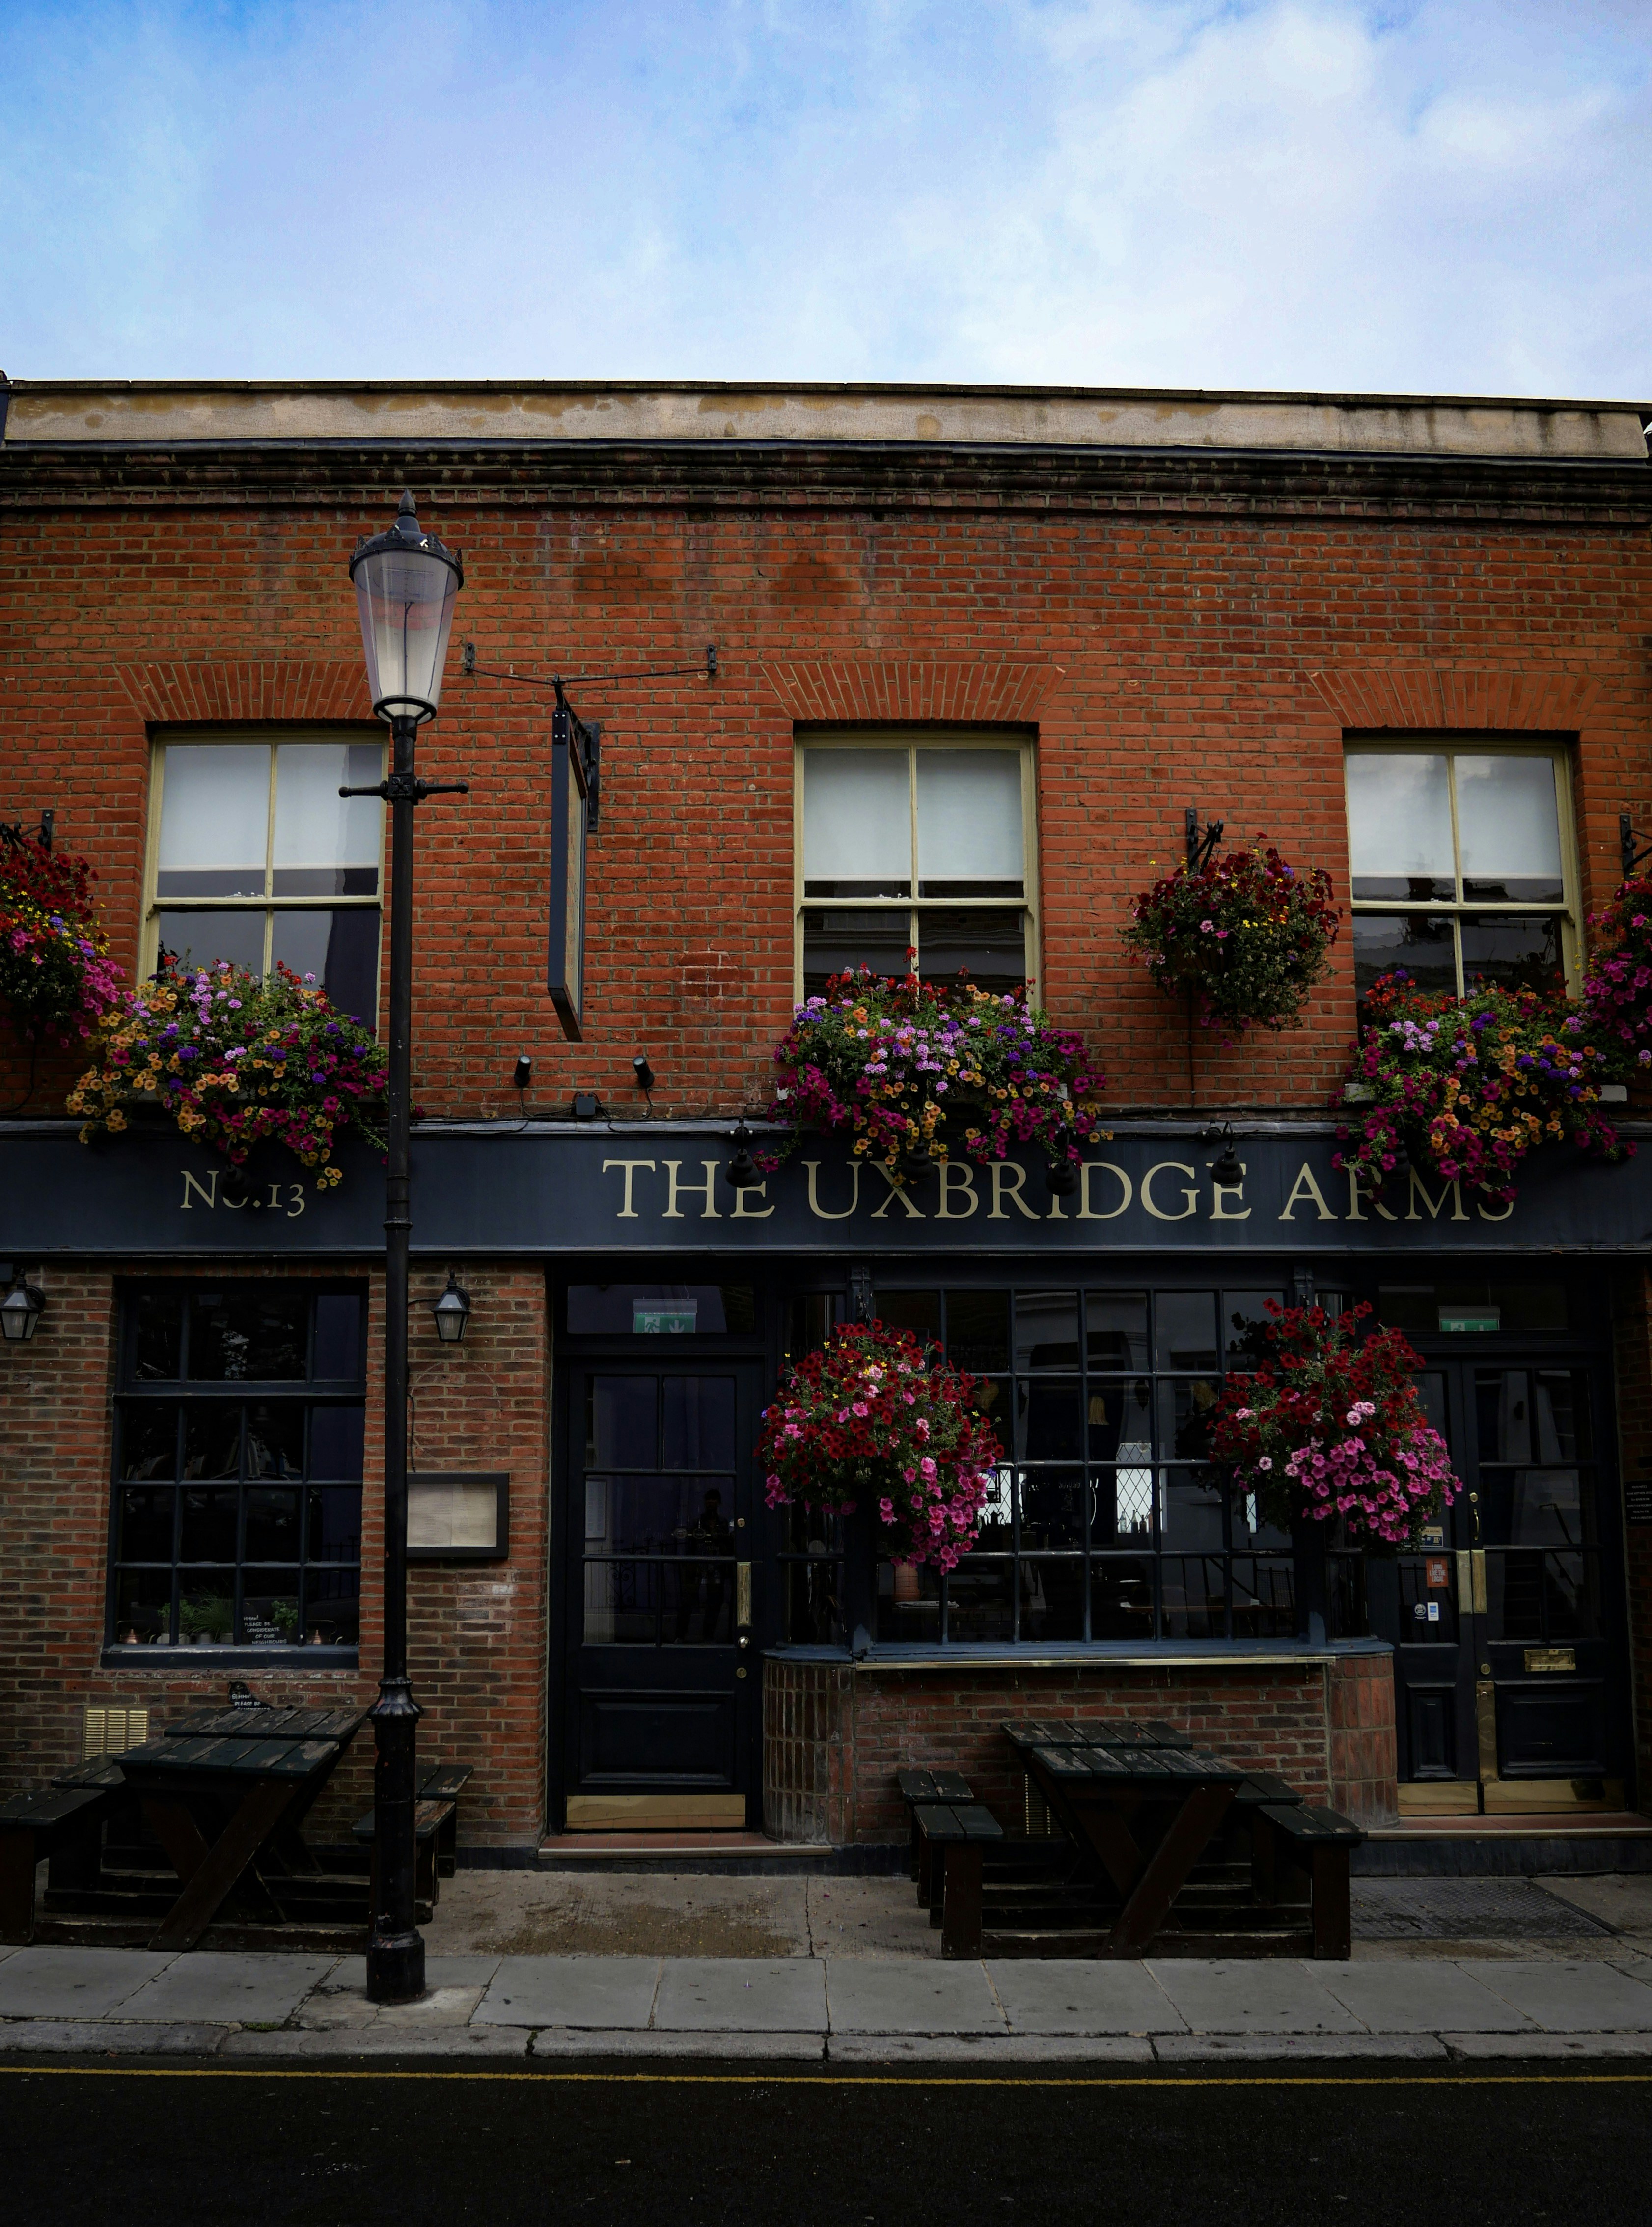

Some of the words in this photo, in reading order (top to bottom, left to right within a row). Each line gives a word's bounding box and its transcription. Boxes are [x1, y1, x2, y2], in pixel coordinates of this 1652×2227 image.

[602, 1159, 775, 1218] THE
[800, 1160, 1252, 1220] UXBRIDGE
[1278, 1162, 1514, 1221] ARMS
